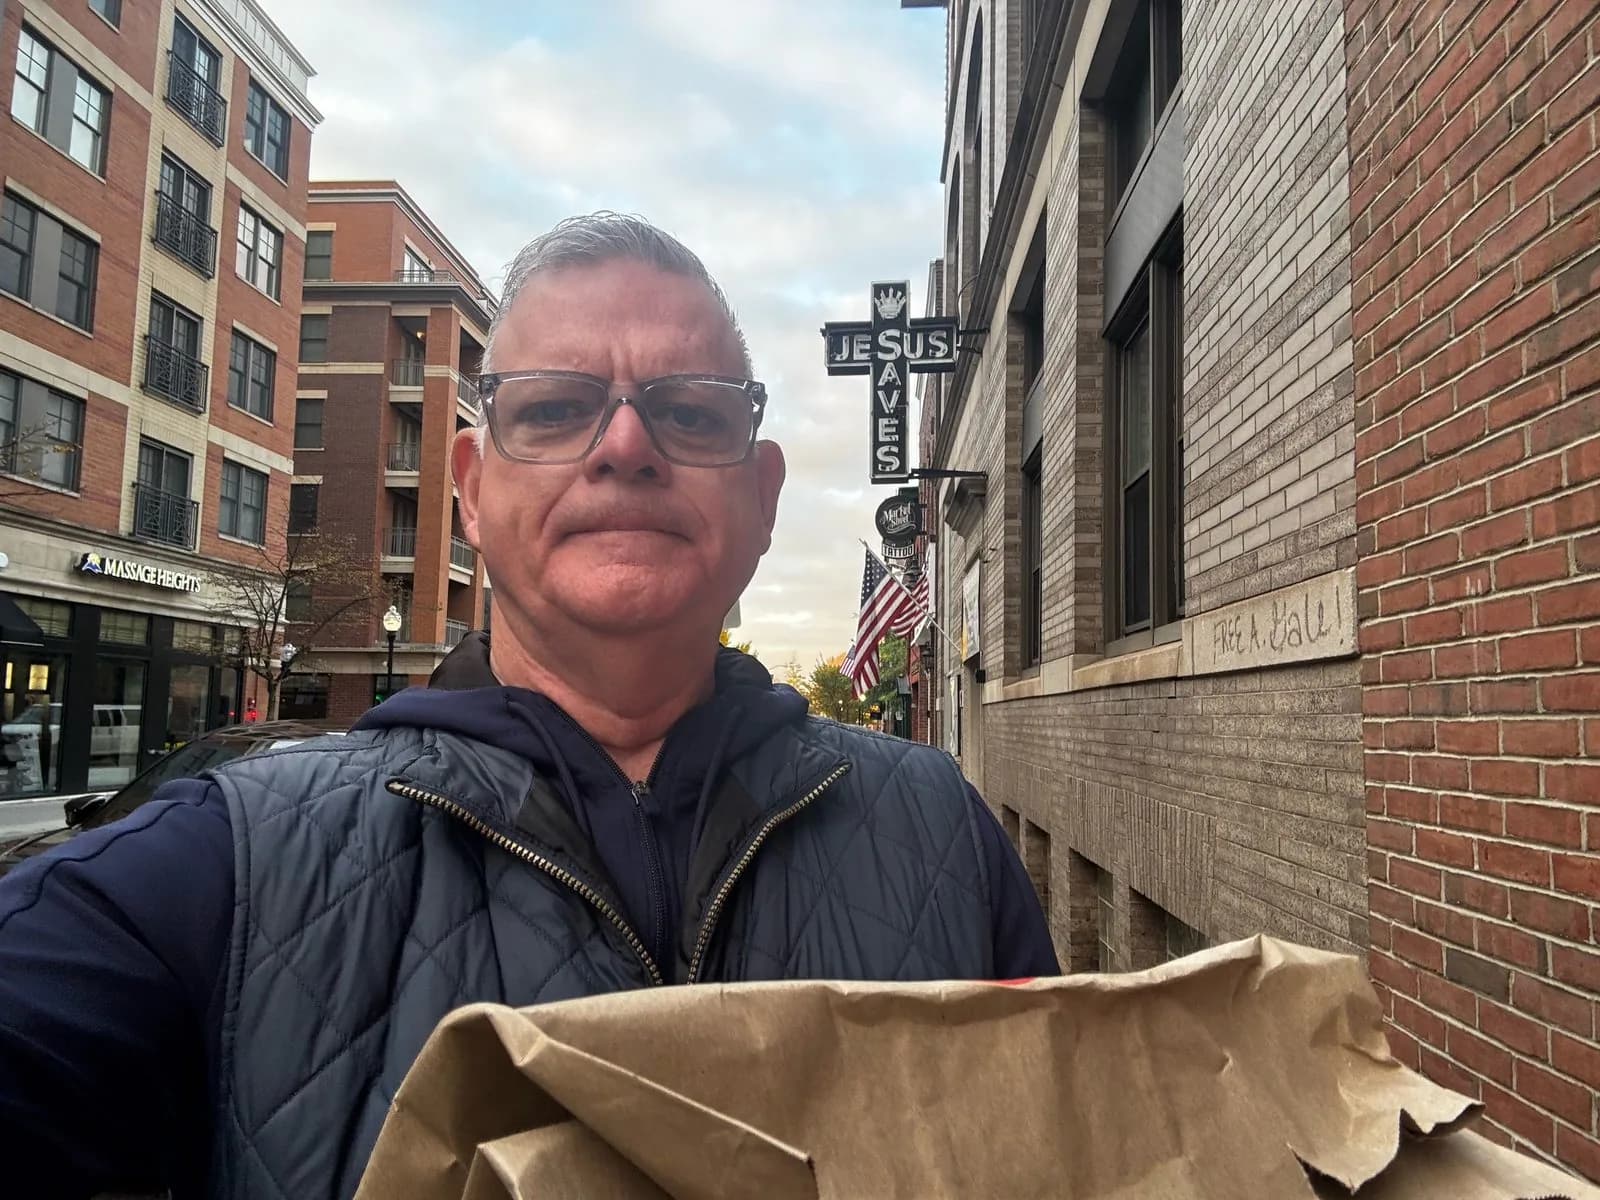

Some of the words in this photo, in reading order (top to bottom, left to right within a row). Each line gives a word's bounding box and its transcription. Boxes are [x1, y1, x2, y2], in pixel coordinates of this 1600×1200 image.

[833, 329, 948, 361] JESUS
[876, 329, 902, 472] SAVES
[883, 545, 913, 557] TATTOO
[104, 557, 156, 584] MASSAGE
[157, 568, 201, 593] HEIGHTS
[1213, 615, 1245, 665] FREE
